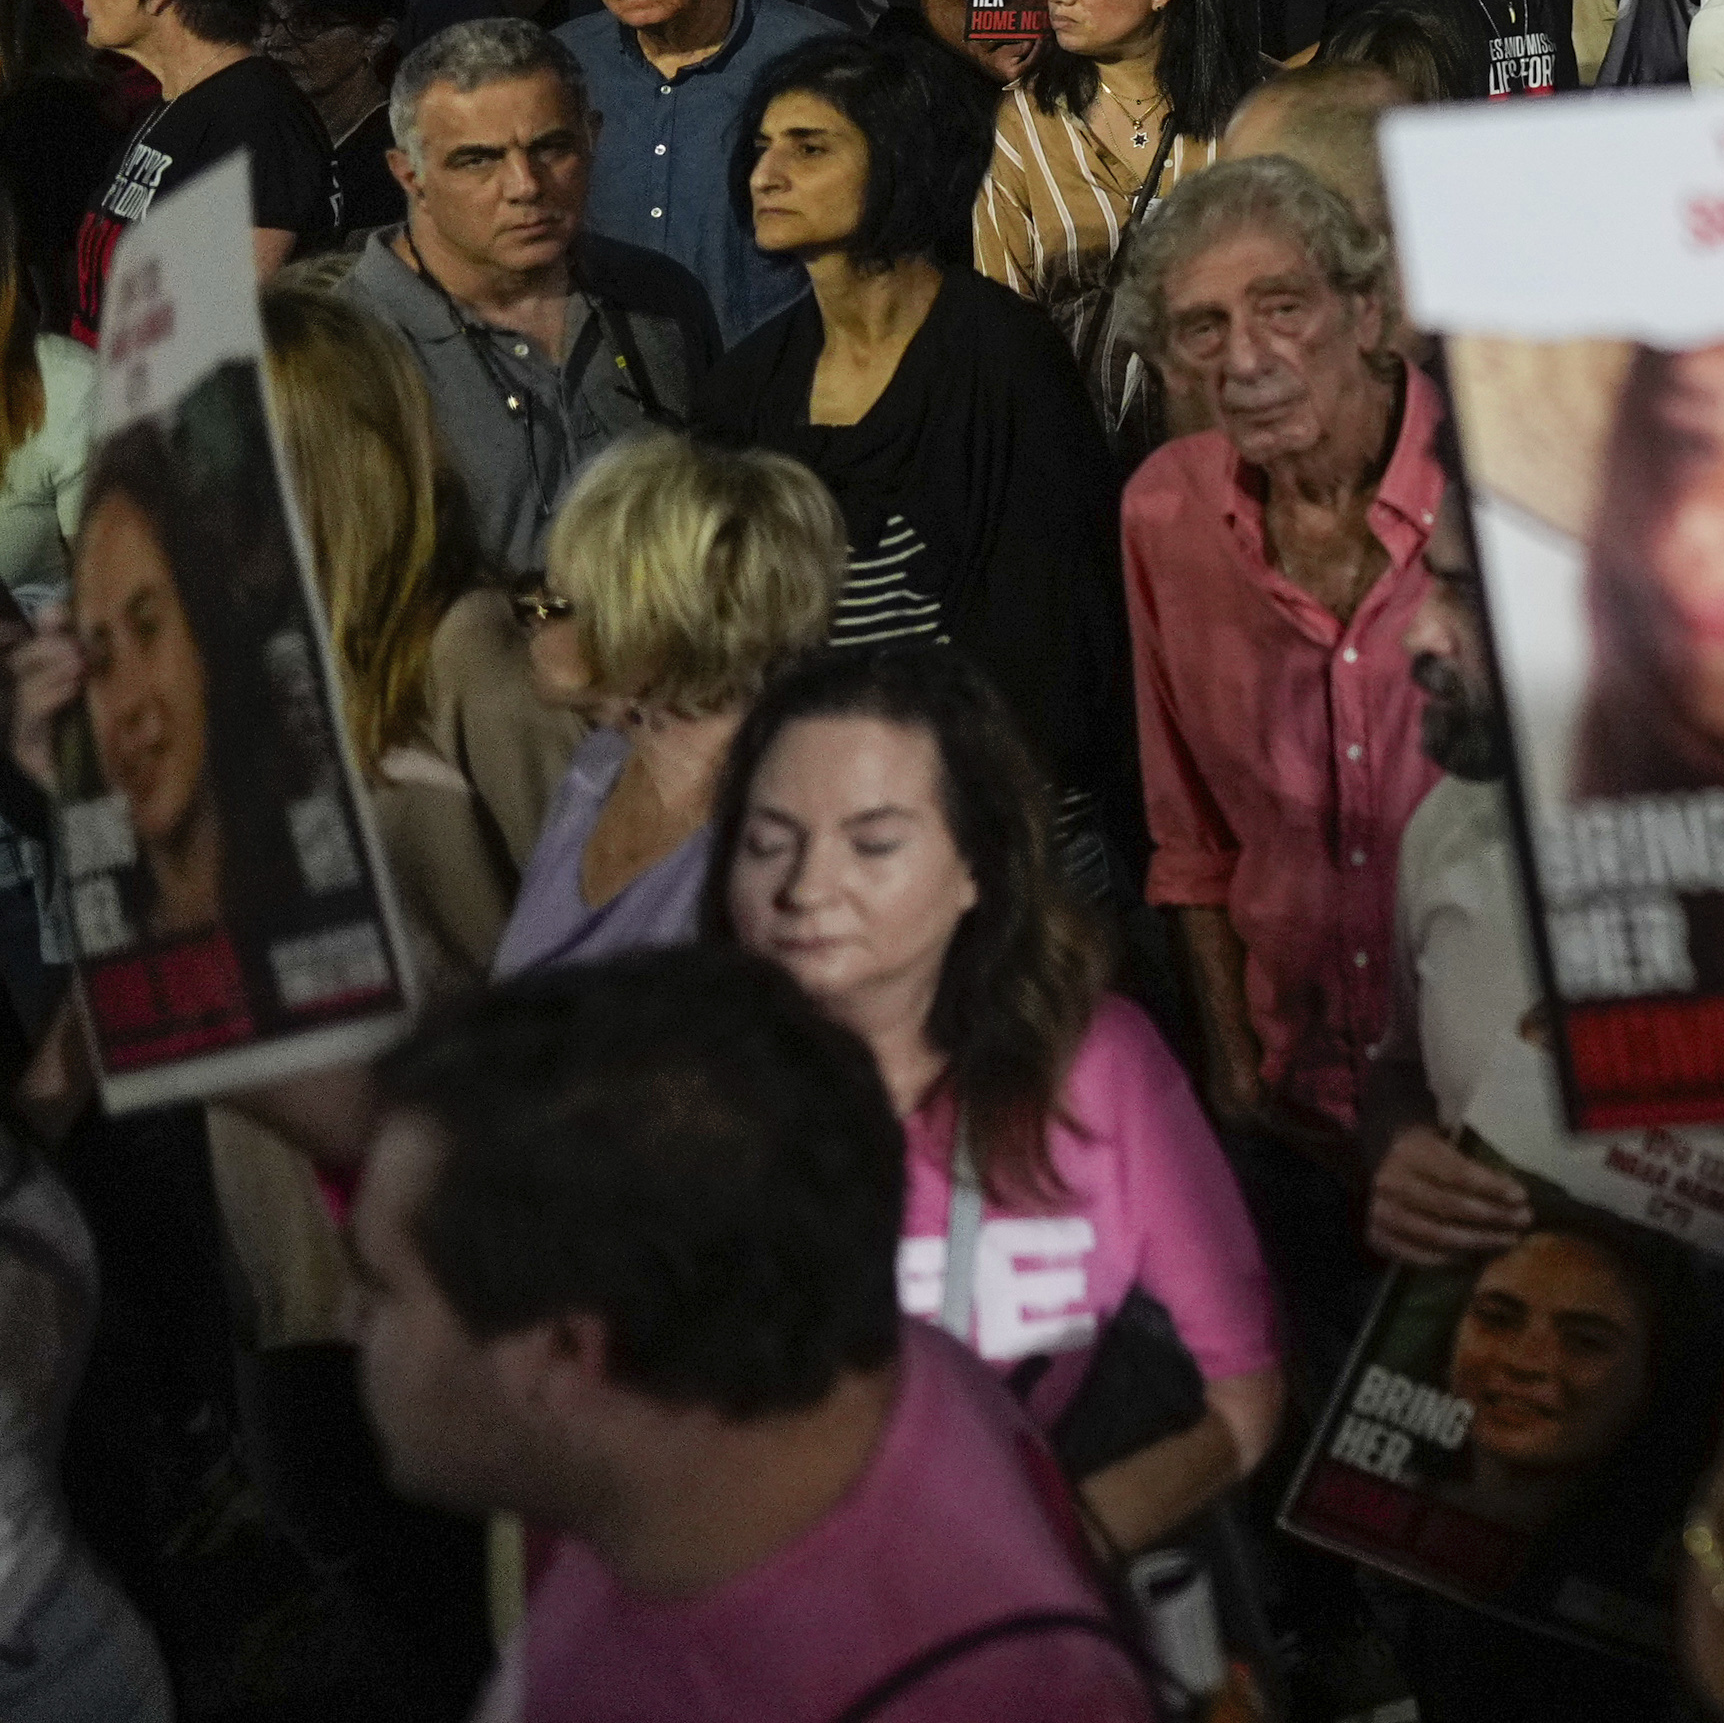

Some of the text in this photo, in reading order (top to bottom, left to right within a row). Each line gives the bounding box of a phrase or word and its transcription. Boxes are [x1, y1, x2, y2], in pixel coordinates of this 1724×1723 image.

[971, 10, 1050, 30] HOME NO
[1350, 1364, 1476, 1453] BRING
[1330, 1414, 1417, 1484] HER
